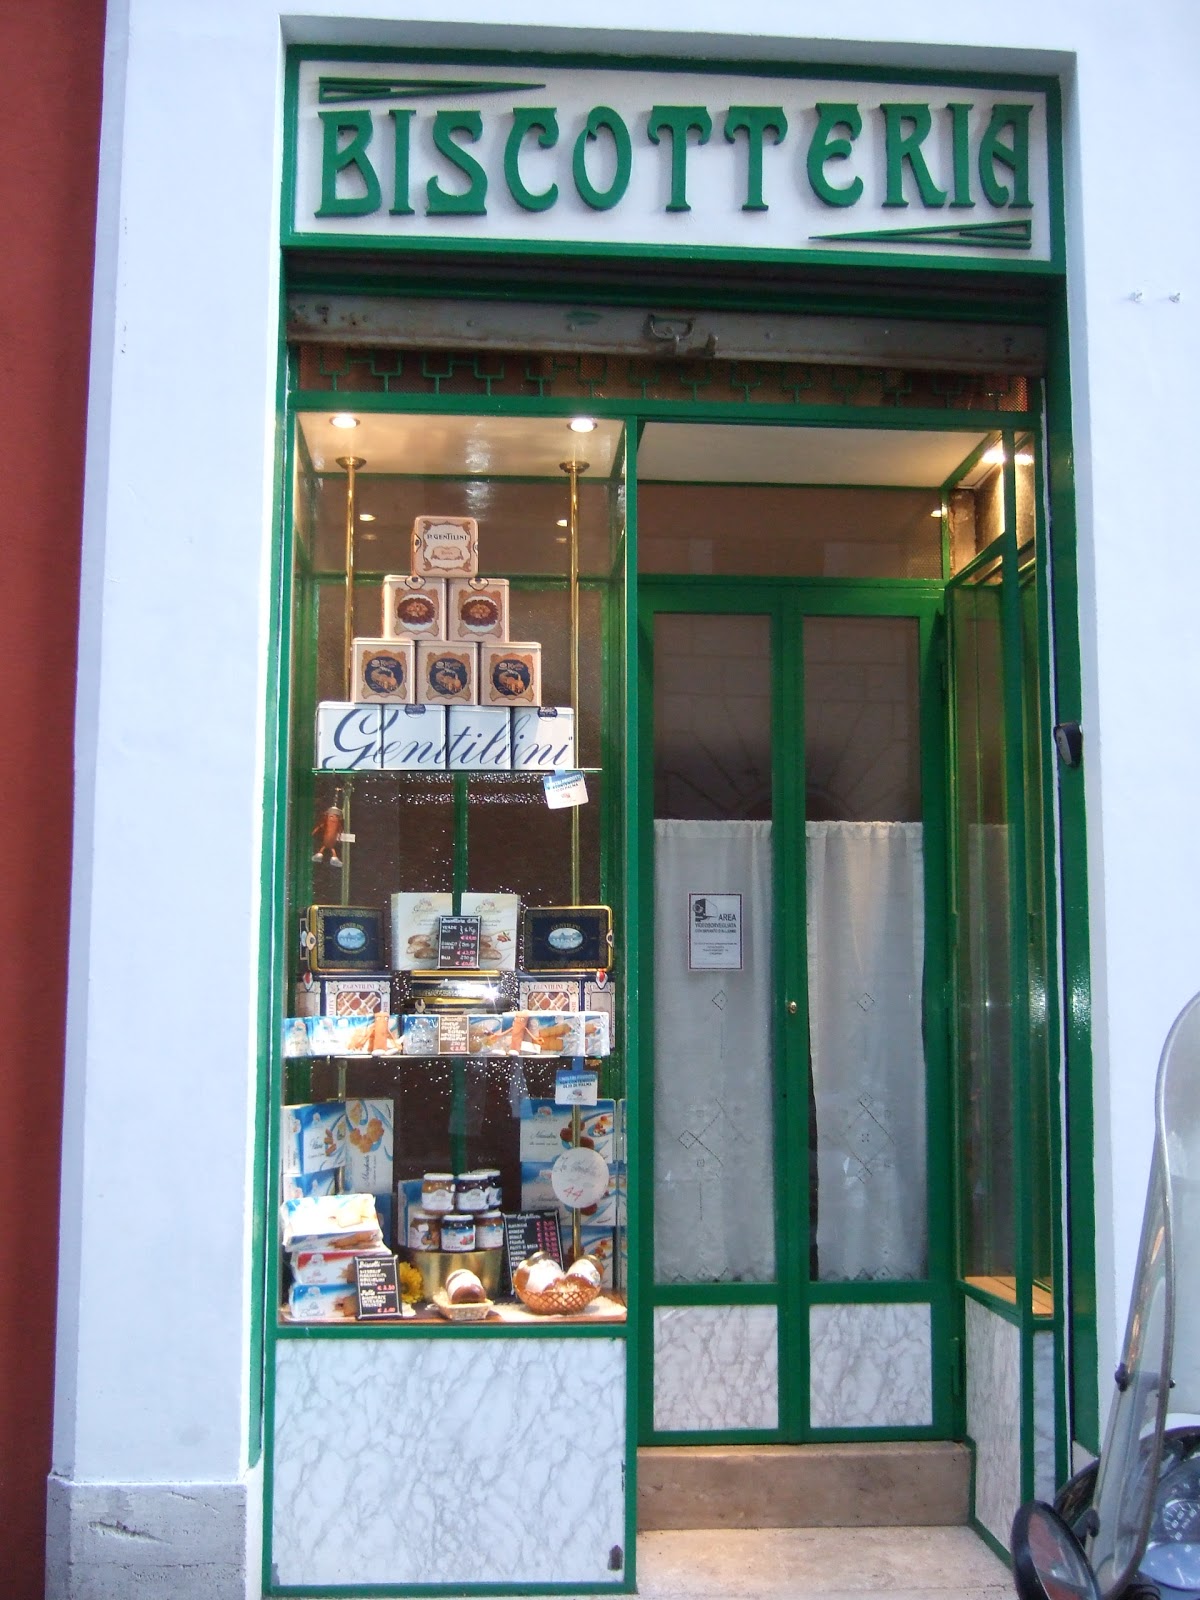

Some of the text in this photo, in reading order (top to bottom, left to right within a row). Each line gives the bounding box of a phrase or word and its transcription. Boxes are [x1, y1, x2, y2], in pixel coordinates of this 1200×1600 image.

[314, 103, 1034, 218] BISCOTTERIA
[322, 707, 569, 768] Gentilini
[718, 913, 737, 921] AREA
